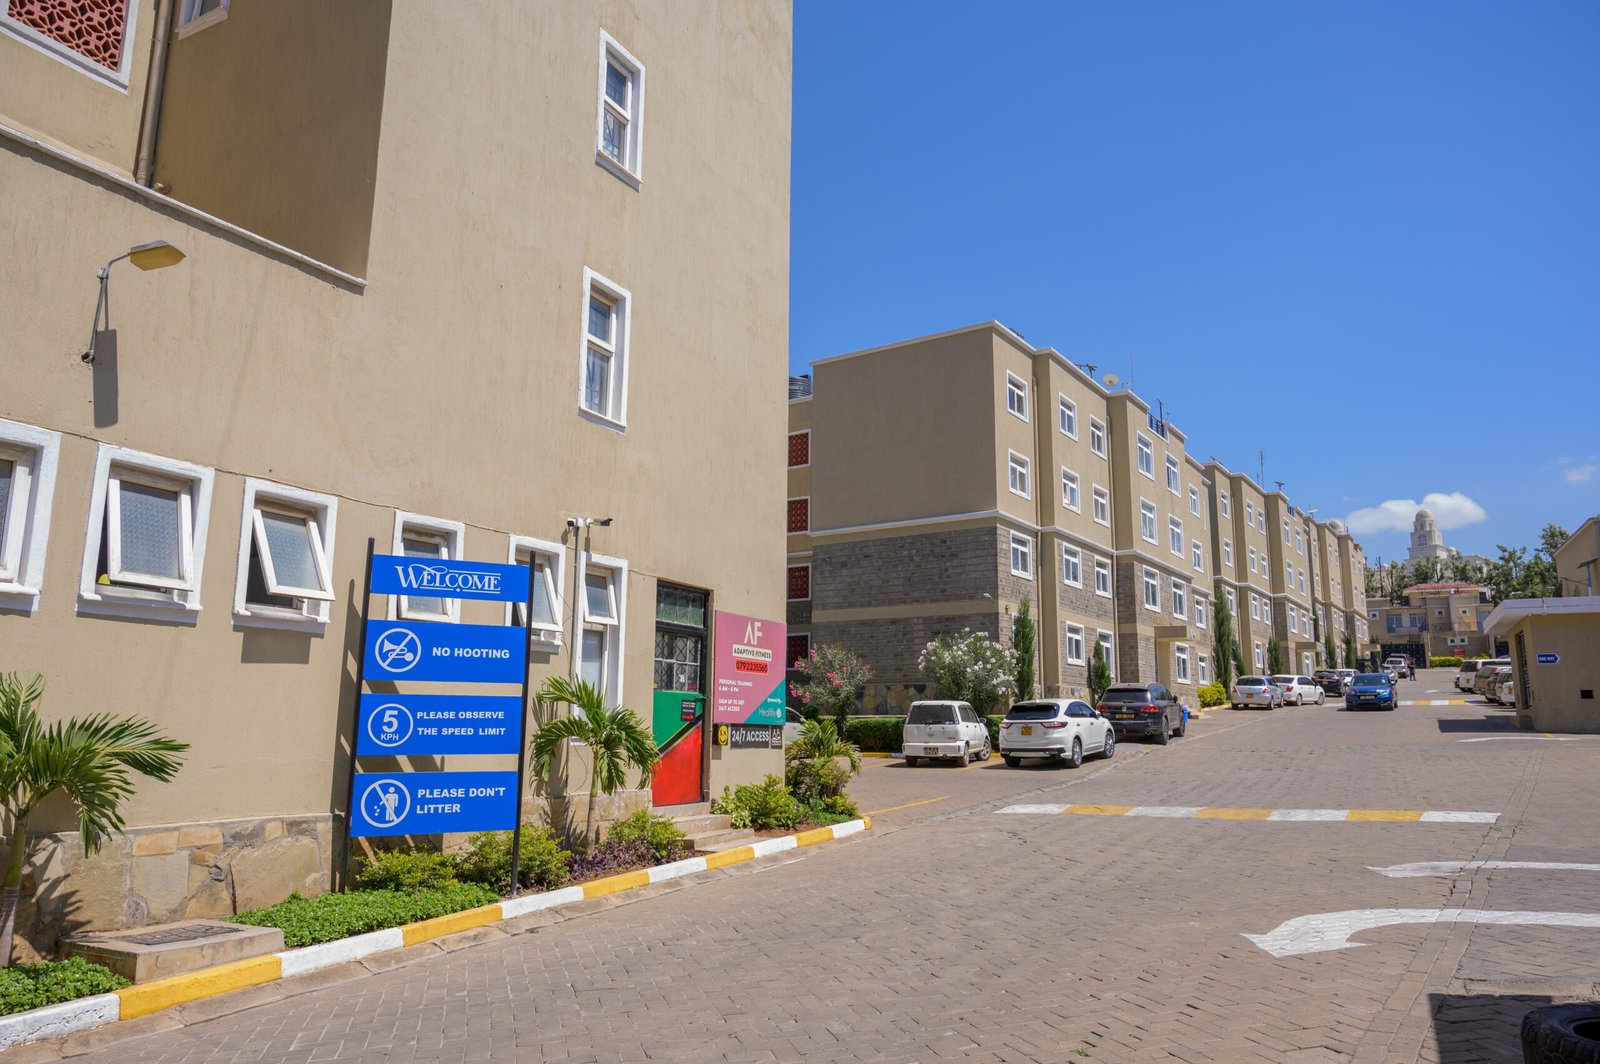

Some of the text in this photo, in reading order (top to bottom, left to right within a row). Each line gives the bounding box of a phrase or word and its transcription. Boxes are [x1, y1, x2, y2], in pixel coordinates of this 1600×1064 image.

[394, 564, 501, 591] WELCOME
[744, 621, 763, 645] AF
[432, 647, 510, 659] NO HOOTING
[734, 647, 772, 660] ADAPTIVE FITNESS
[382, 709, 399, 733] 5
[417, 711, 505, 720] PLEASE OBSERVE
[380, 733, 399, 741] KPH
[417, 727, 506, 736] THE SPEED LIMIT
[731, 727, 746, 744] 24/7
[746, 730, 769, 742] ACCESS
[417, 787, 506, 799] PLEASE DON'T
[416, 803, 461, 814] LITTER
